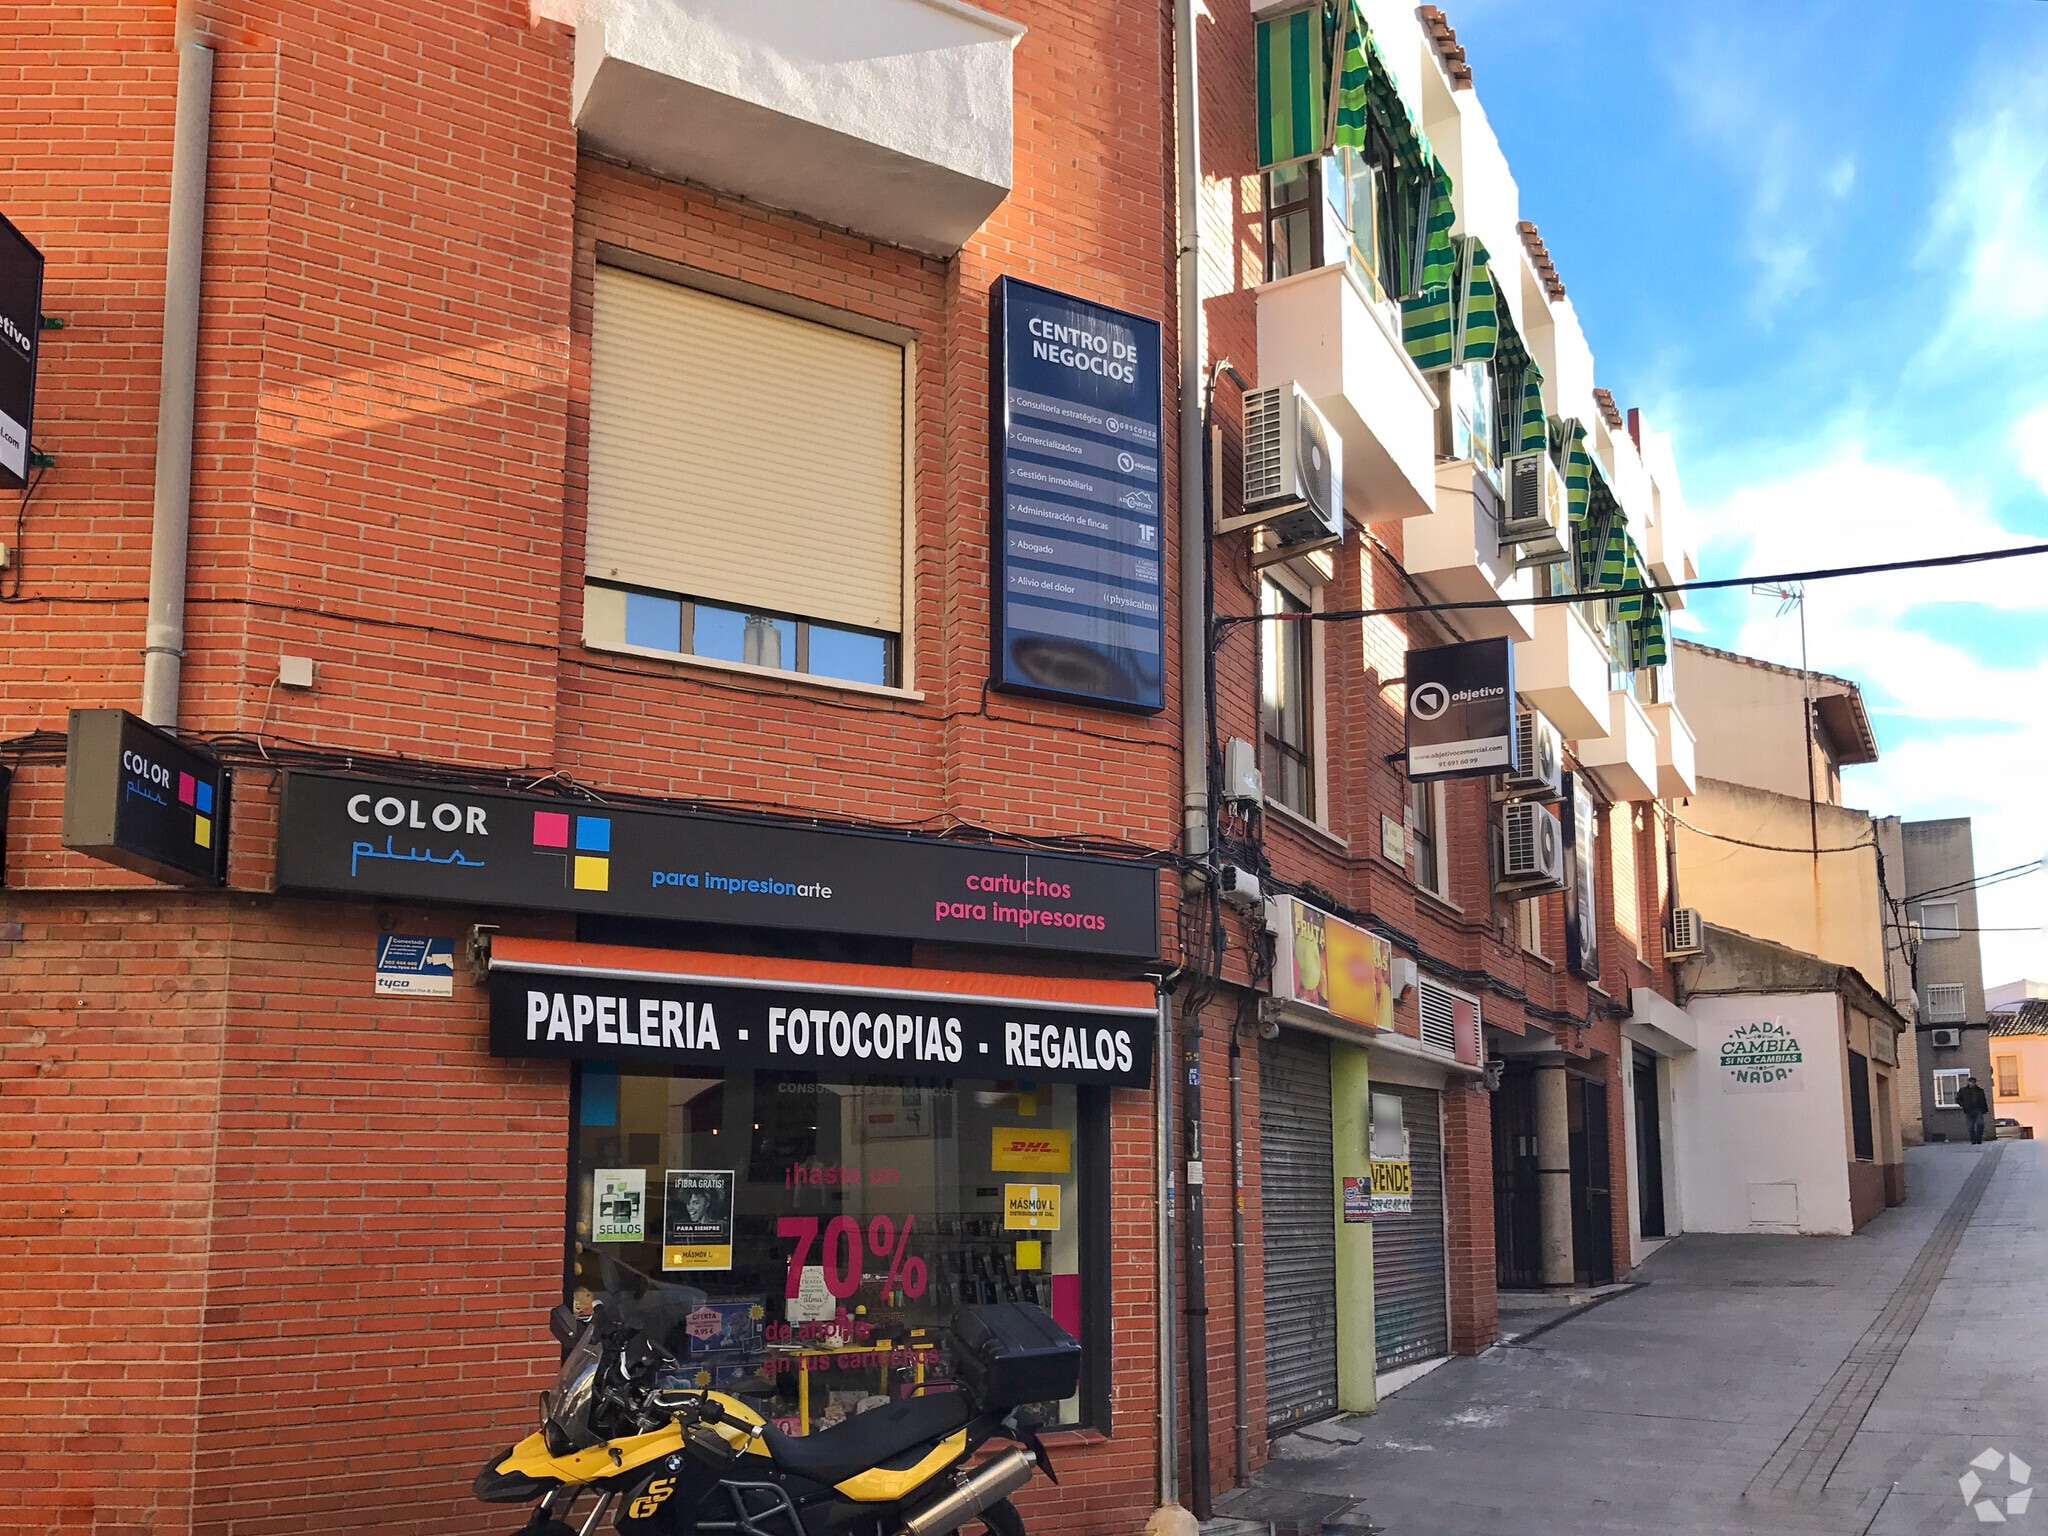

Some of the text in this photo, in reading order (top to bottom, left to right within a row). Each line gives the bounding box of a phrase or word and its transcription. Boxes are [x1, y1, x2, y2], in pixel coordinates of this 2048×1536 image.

[1028, 317, 1138, 364] CENTRO DE
[1033, 340, 1134, 384] NEGOCIOS
[1016, 397, 1102, 426] Consultoría estratégica
[1016, 432, 1083, 455] Comercializadora
[1016, 468, 1093, 492] Gestión inmobiliaria
[1017, 503, 1109, 531] Administración de fincas
[1017, 539, 1054, 555] Abogado
[1017, 575, 1075, 594] Alivio del dolor
[1452, 686, 1504, 701] objetivo
[123, 750, 170, 789] COLOR
[1447, 759, 1459, 767] 691
[126, 779, 168, 806] plus
[347, 793, 489, 836] COLOR
[351, 835, 486, 877] plus
[652, 871, 833, 899] para impresionarte
[966, 873, 1072, 899] cartuchos
[935, 900, 1106, 931] para impresoras
[378, 978, 410, 988] tyco
[526, 990, 1133, 1073] PAPELERIA FOTOCOPIAS REGALOS
[1734, 1021, 1784, 1039] NADA
[1721, 1038, 1800, 1055] CAMBIA
[1725, 1054, 1798, 1065] SI NO CAMBIAS
[1736, 1068, 1788, 1084] NADA
[1010, 1141, 1051, 1153] DHL
[674, 1179, 725, 1189] ¡FIBRA GRATIS!
[785, 1161, 899, 1190] ¡hasta un
[1370, 1163, 1410, 1192] VENDE
[599, 1224, 642, 1234] SELLOS
[777, 1214, 928, 1299] 70%
[692, 1313, 717, 1321] OFERTA
[765, 1320, 790, 1340] de
[763, 1347, 940, 1374] en tus cartuchos
[629, 1477, 676, 1518] GS
